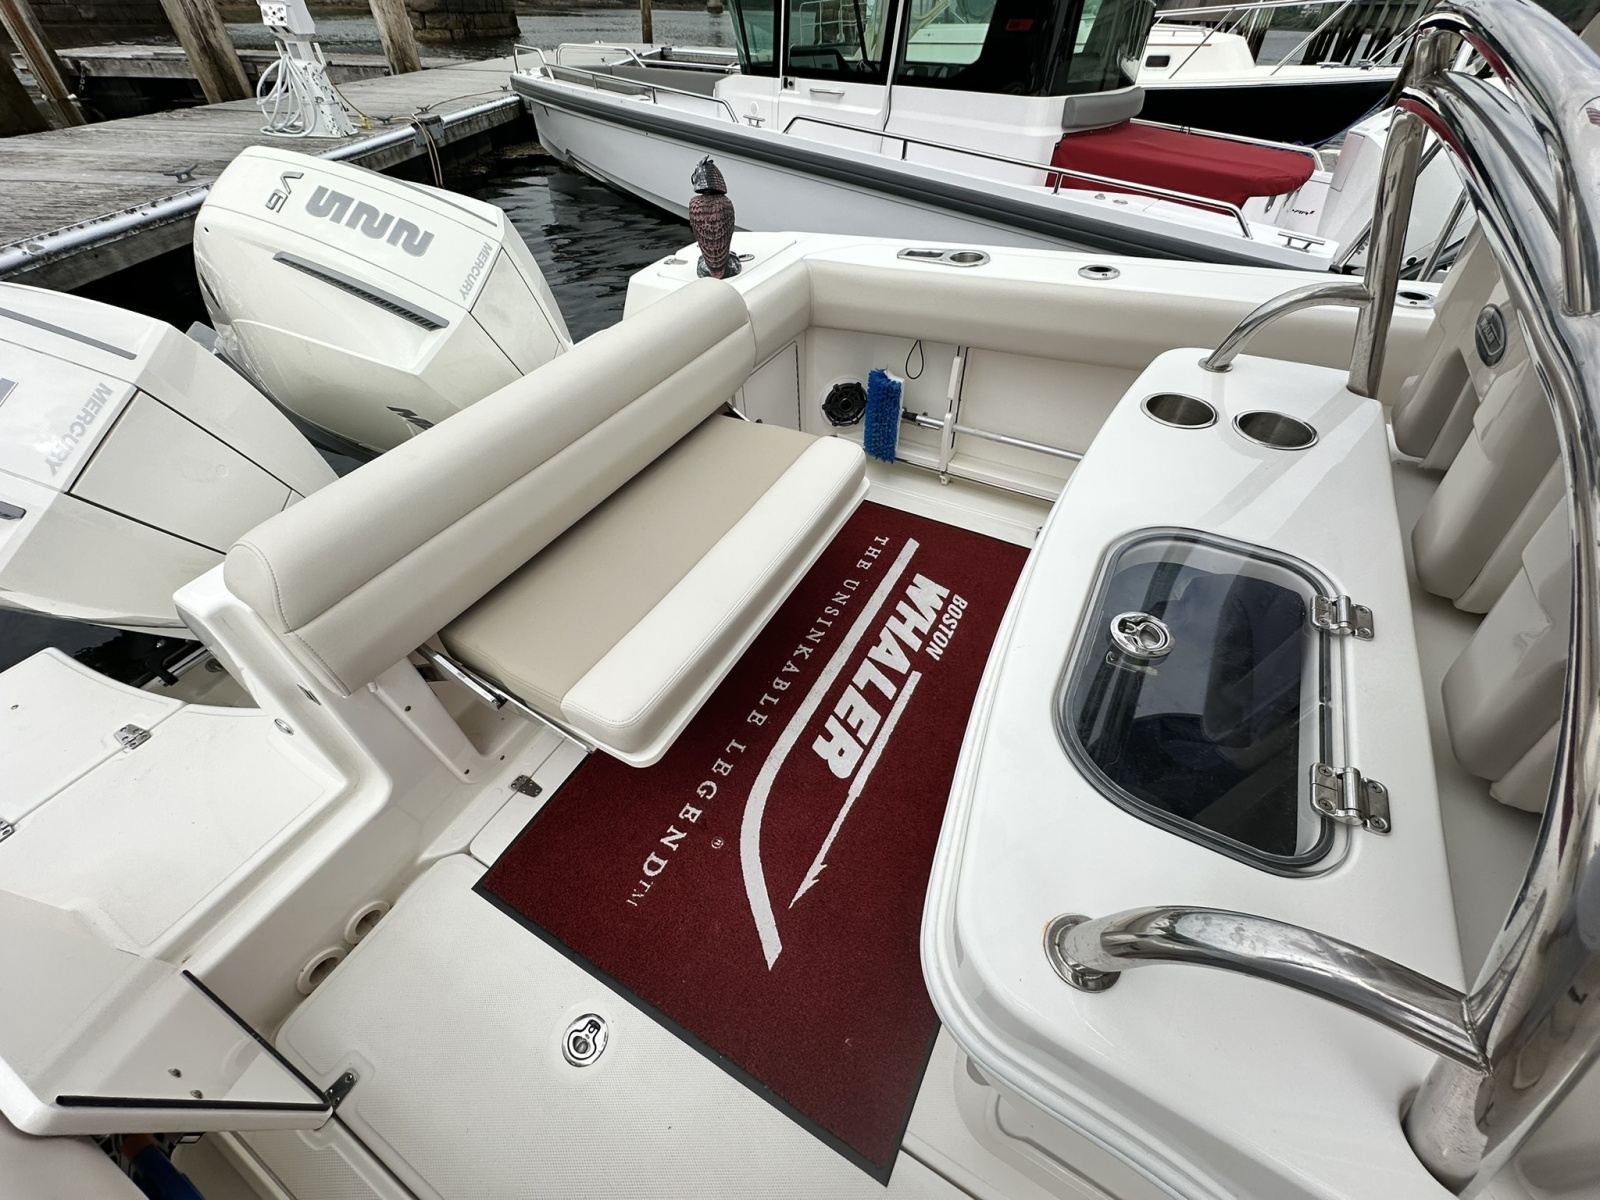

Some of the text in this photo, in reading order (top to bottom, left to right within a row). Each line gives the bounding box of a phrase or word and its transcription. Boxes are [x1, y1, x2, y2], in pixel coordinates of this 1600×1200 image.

[265, 171, 304, 213] V6
[459, 241, 493, 300] MERCURY
[45, 382, 113, 476] MERCURY
[857, 536, 889, 571] THE
[747, 579, 860, 727] UNSINKABLE
[925, 594, 968, 661] BOSTON
[811, 571, 950, 780] WHALER
